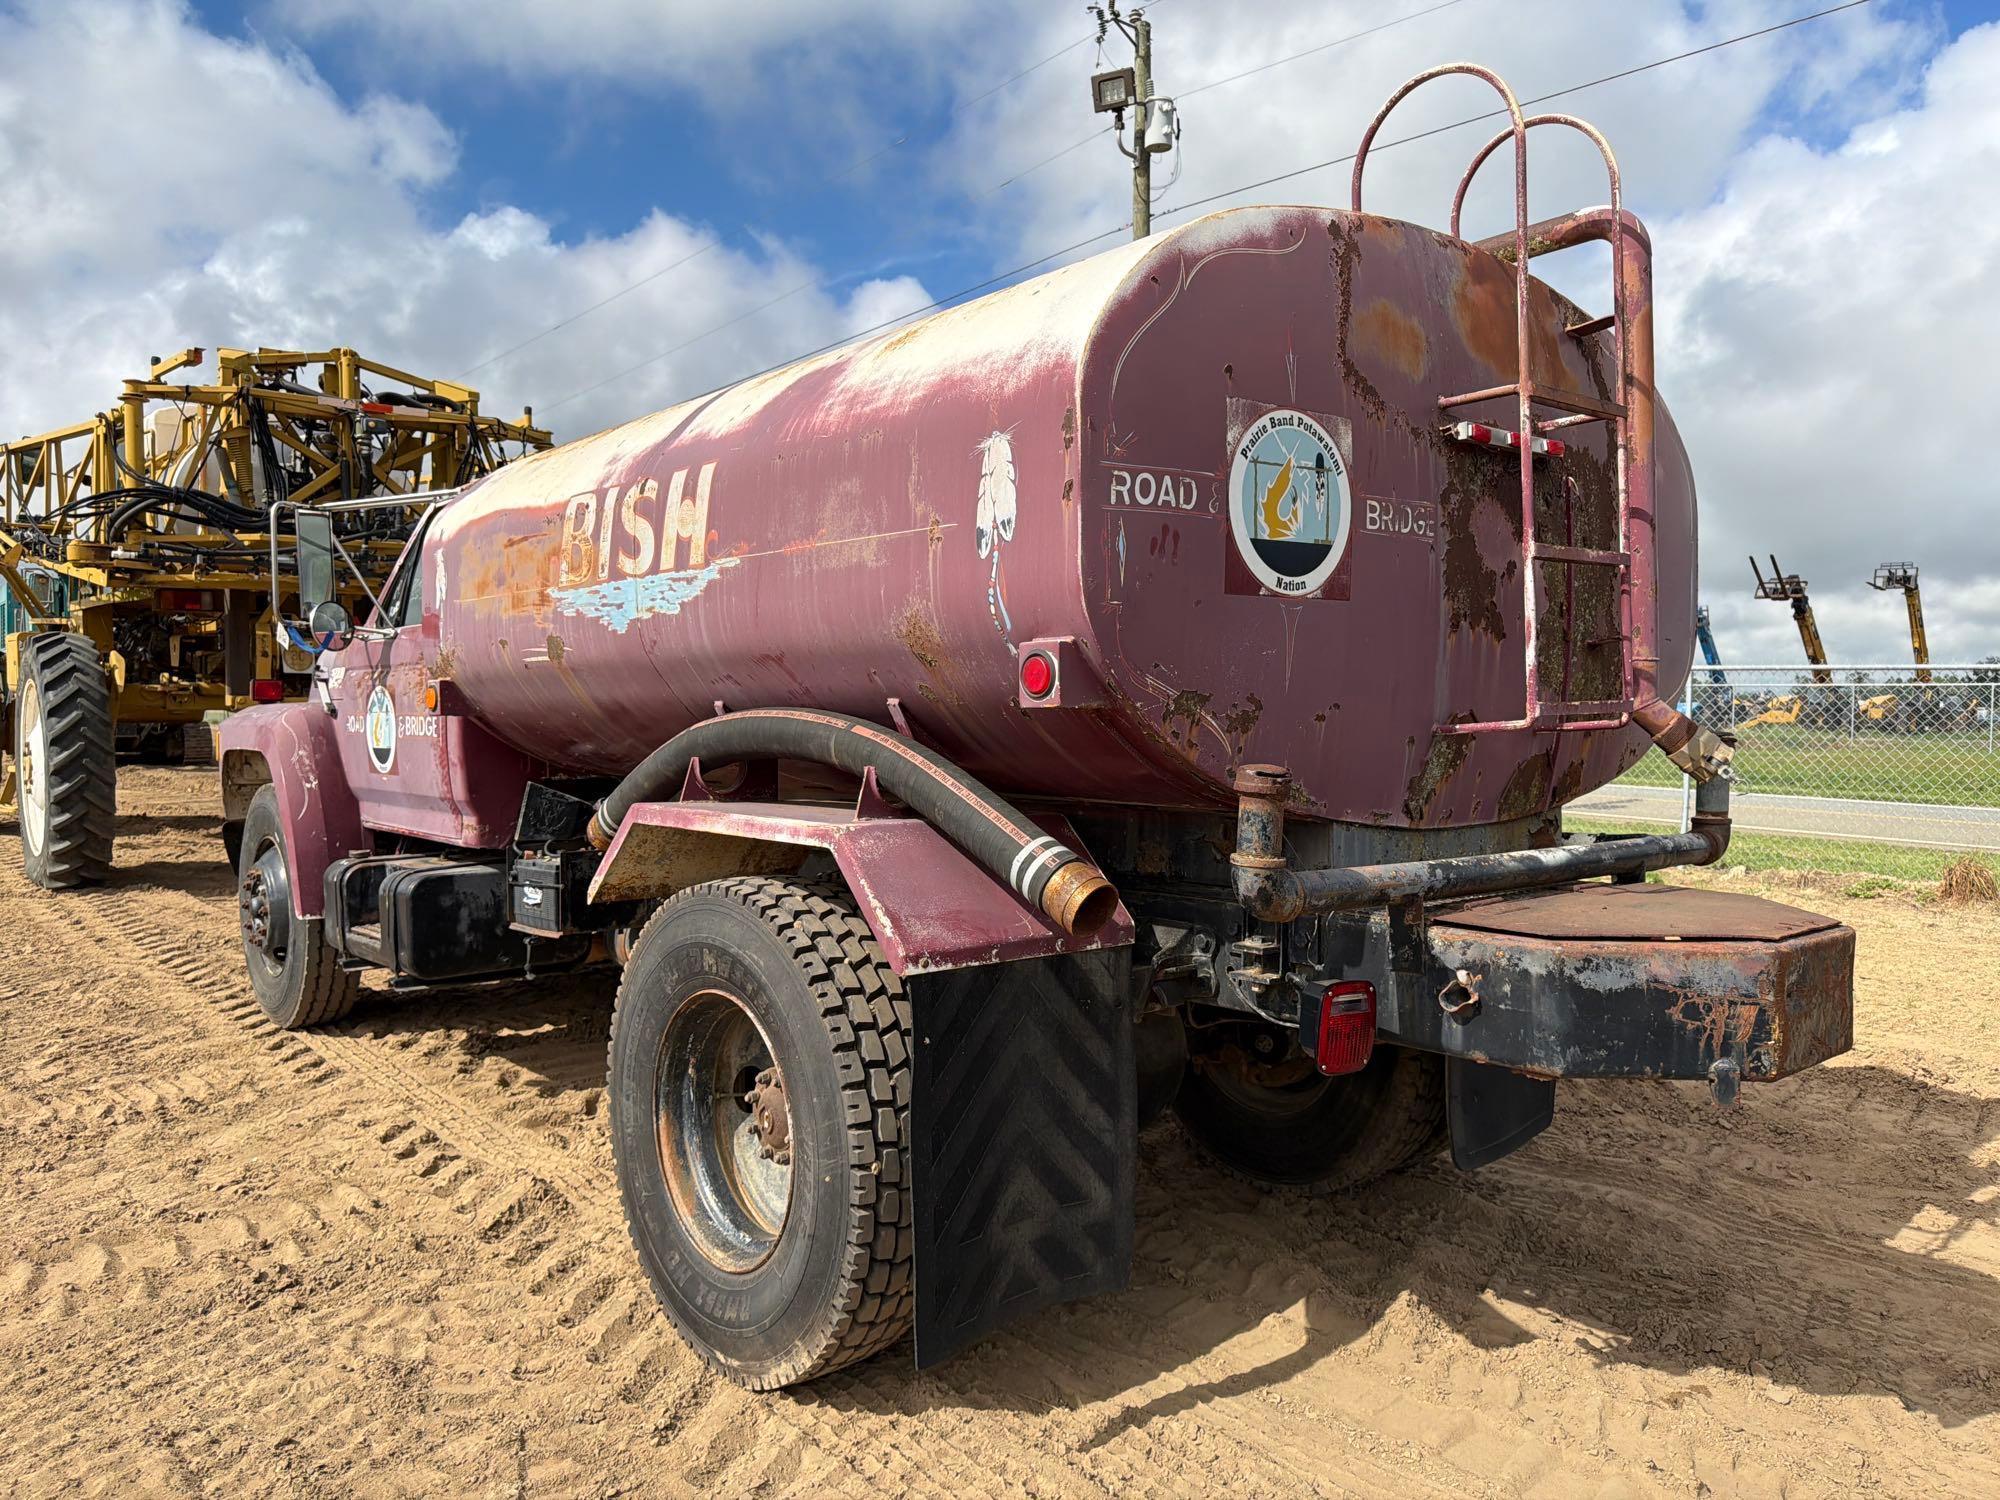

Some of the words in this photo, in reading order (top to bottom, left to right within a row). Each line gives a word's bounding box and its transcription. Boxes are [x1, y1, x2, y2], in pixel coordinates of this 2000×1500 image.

[1240, 424, 1269, 460] Prairie
[1269, 414, 1295, 429] Band
[1297, 416, 1344, 477] Potawatomi
[1110, 470, 1198, 510] ROAD
[1366, 499, 1435, 537] BRIDGE
[558, 461, 718, 588] BISH
[1275, 576, 1307, 592] Nation
[405, 715, 438, 738] BRIDGE
[917, 759, 934, 773] HOSE
[931, 769, 950, 785] TRUCK
[949, 782, 965, 797] TANK
